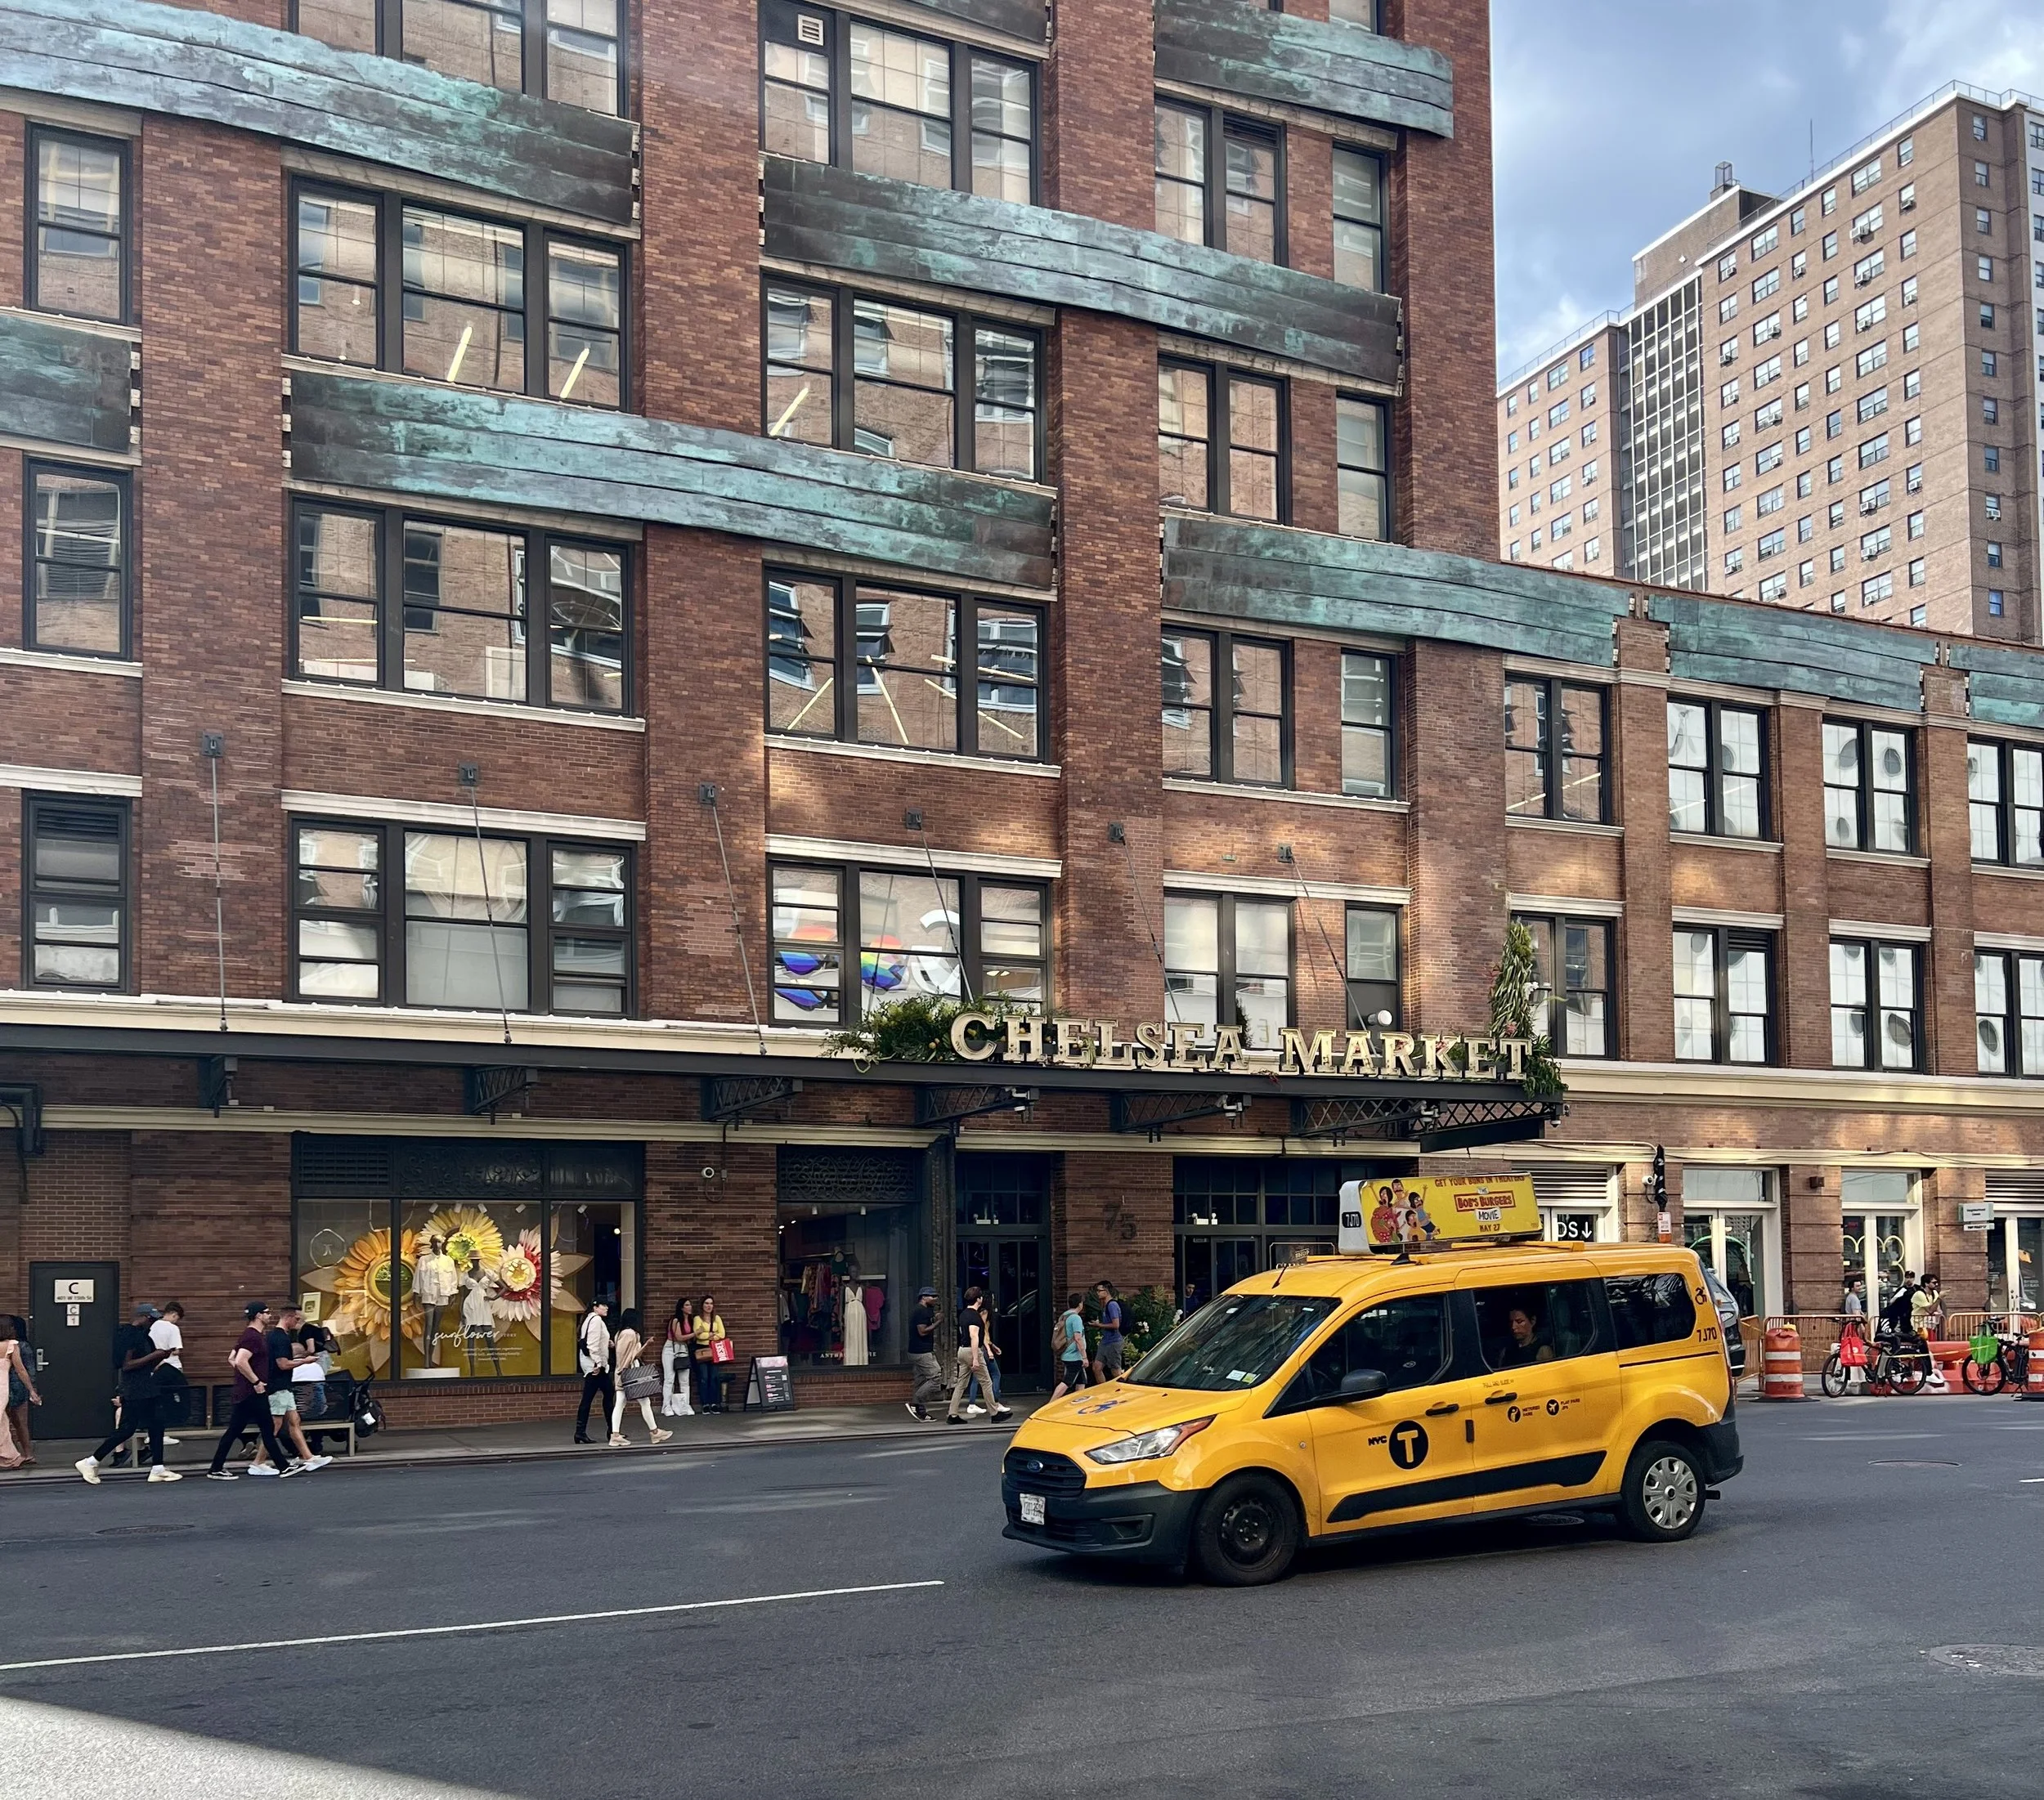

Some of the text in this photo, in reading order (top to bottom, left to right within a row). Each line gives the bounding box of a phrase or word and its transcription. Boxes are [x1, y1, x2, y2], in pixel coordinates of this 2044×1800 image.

[950, 1011, 1533, 1080] CHELSEA MARKET
[1435, 1175, 1526, 1188] GET YOUR BUNS IN THEATERS
[1457, 1195, 1513, 1209] BOB'S BURGERS
[1345, 1213, 1360, 1227] 7J70
[1478, 1210, 1499, 1220] MOVIE
[1479, 1223, 1500, 1233] MAY 27
[68, 1282, 79, 1295] C
[69, 1306, 78, 1314] C
[1696, 1327, 1718, 1343] 7J70
[1368, 1429, 1419, 1463] NYC T
